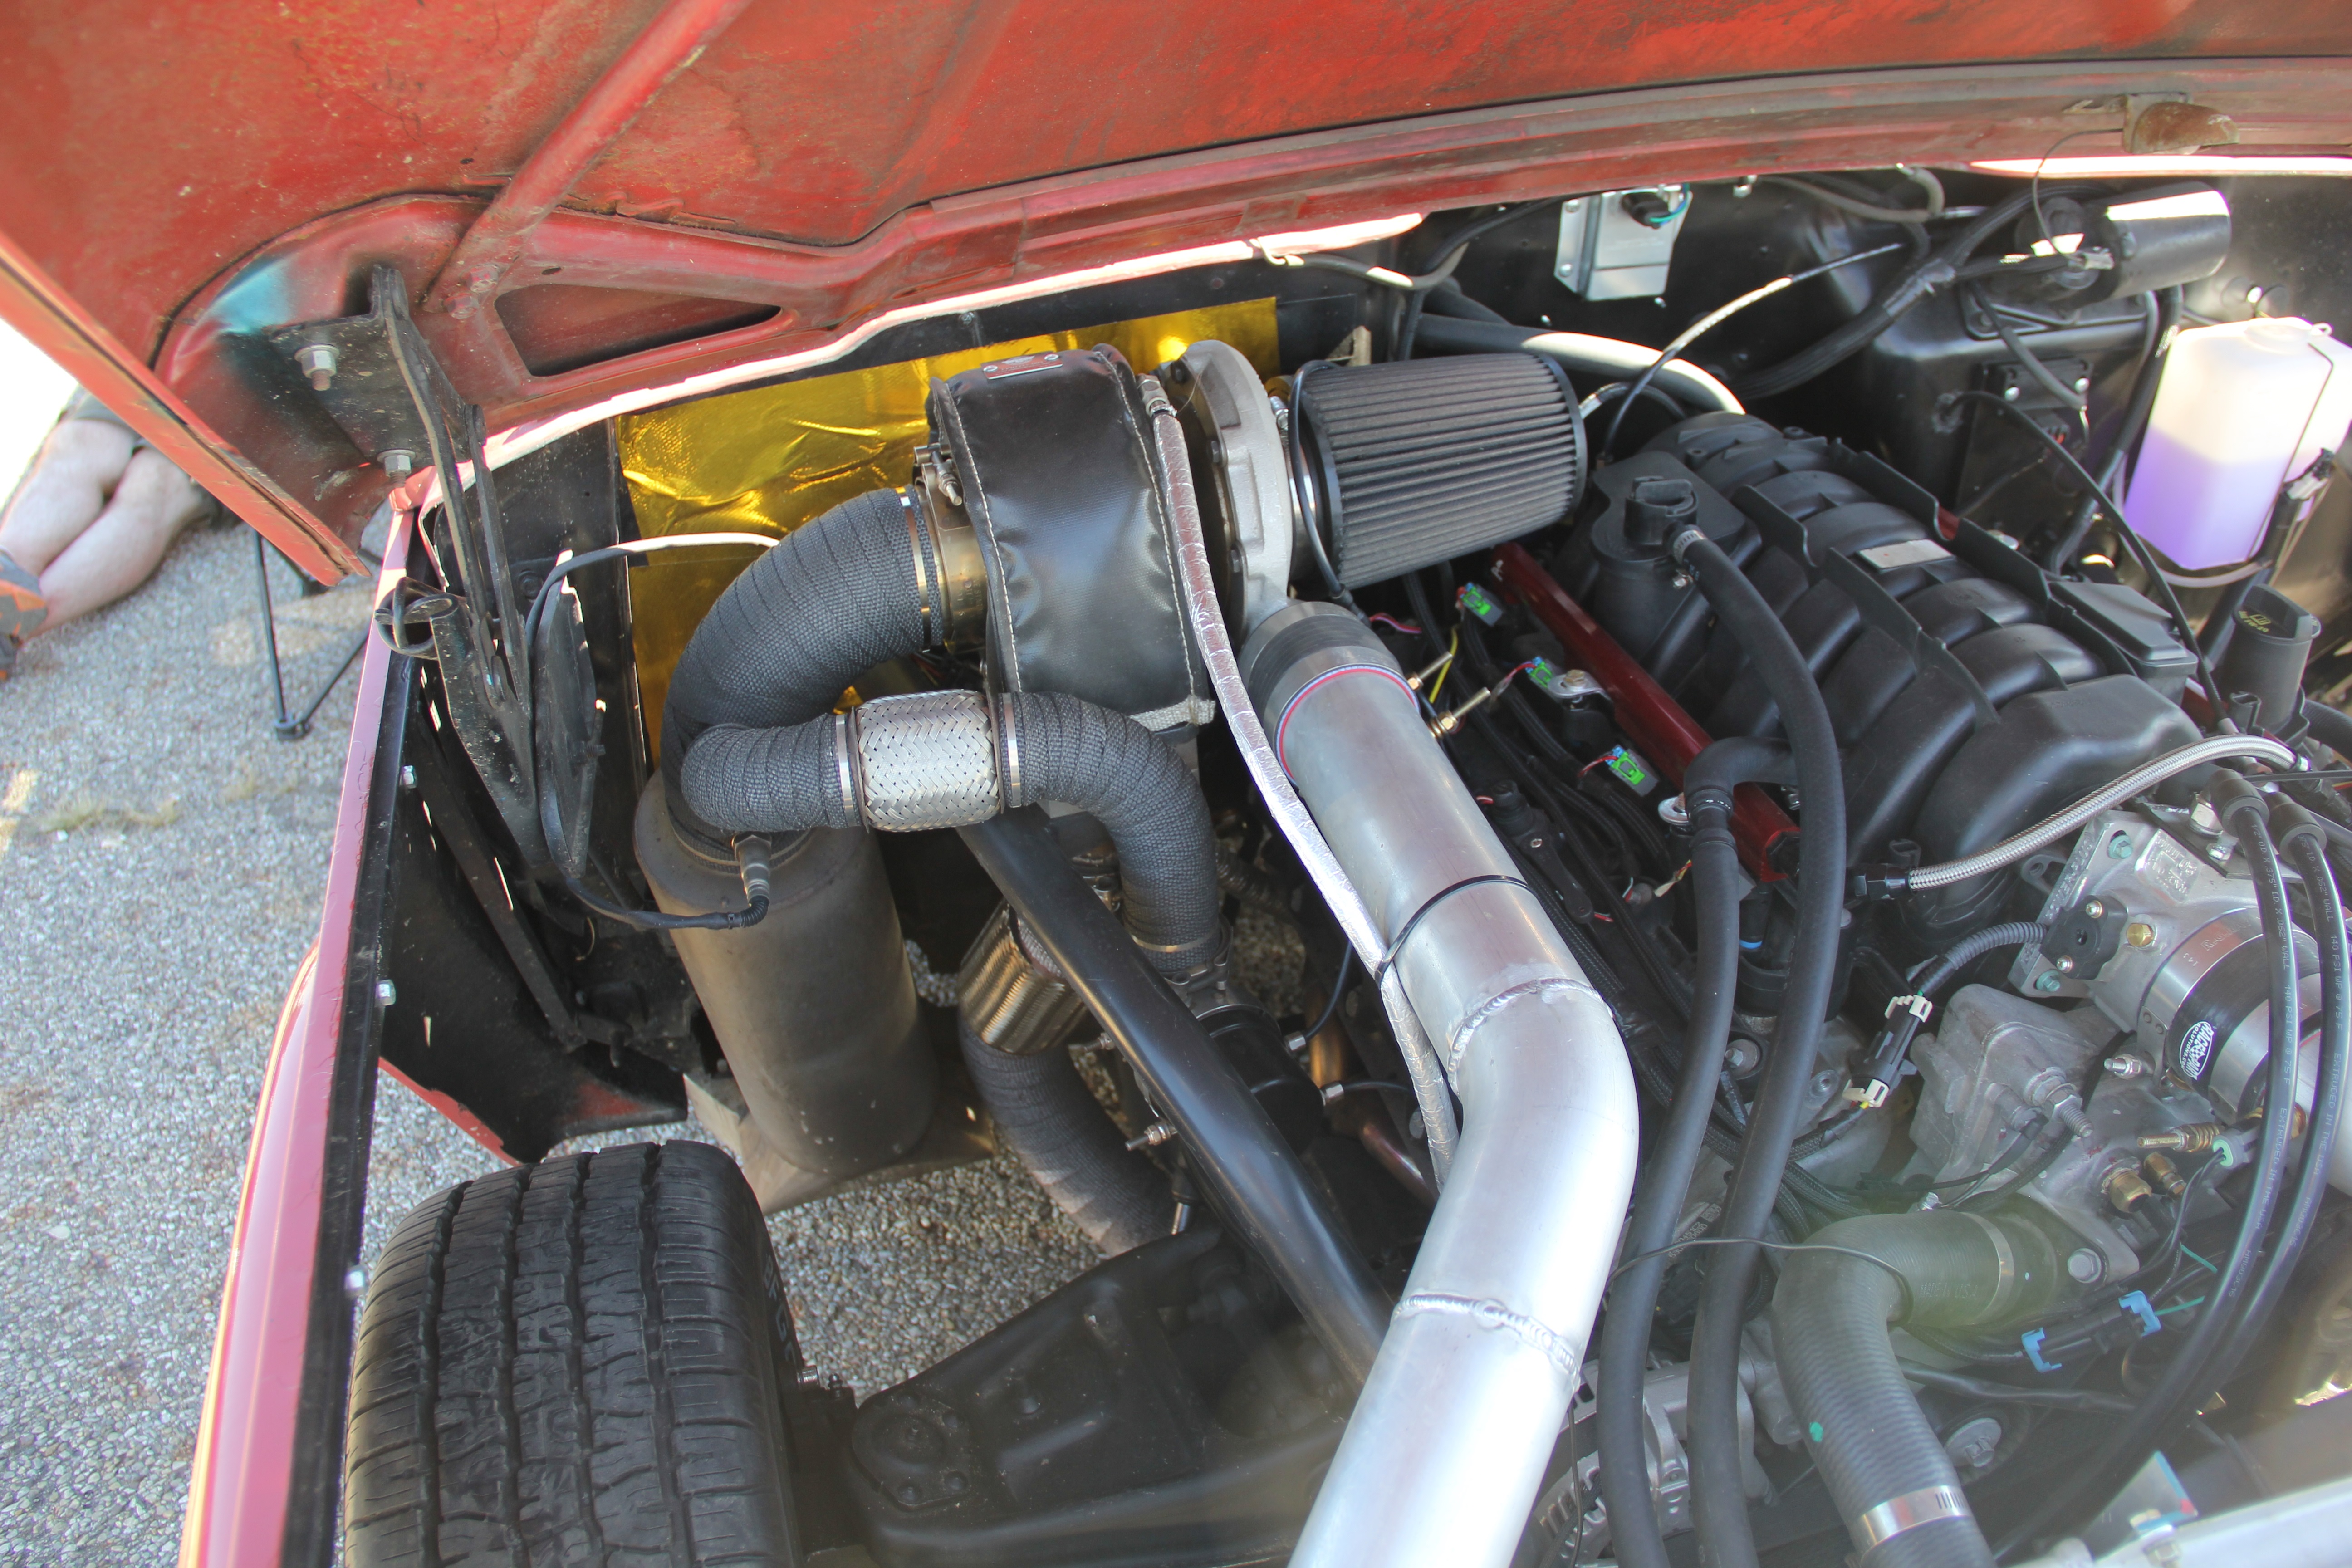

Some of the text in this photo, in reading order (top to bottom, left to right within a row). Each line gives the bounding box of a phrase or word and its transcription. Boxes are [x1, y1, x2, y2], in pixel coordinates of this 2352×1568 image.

[2316, 875, 2328, 897] .062"
[2323, 898, 2334, 922] WALL
[2277, 917, 2288, 942] .062"
[2331, 935, 2339, 951] 140
[2282, 946, 2291, 970] WALL
[2332, 954, 2341, 971] PSI
[2335, 975, 2342, 989] WP
[2283, 985, 2292, 1002] 140
[2335, 1005, 2343, 1019] 75
[2335, 1022, 2342, 1031] F
[2285, 1029, 2293, 1044] WP
[2284, 1048, 2293, 1056] @
[2283, 1061, 2292, 1076] 75
[2283, 1078, 2291, 1086] F
[2328, 1052, 2342, 1108] EXTRUDED
[2326, 1113, 2334, 1125] IN
[2274, 1107, 2288, 1165] EXTRUDED
[2321, 1130, 2331, 1151] THE
[2313, 1154, 2324, 1175] USA
[2268, 1168, 2278, 1181] IN
[2262, 1186, 2272, 1205] THE
[2255, 1209, 2267, 1230] USA
